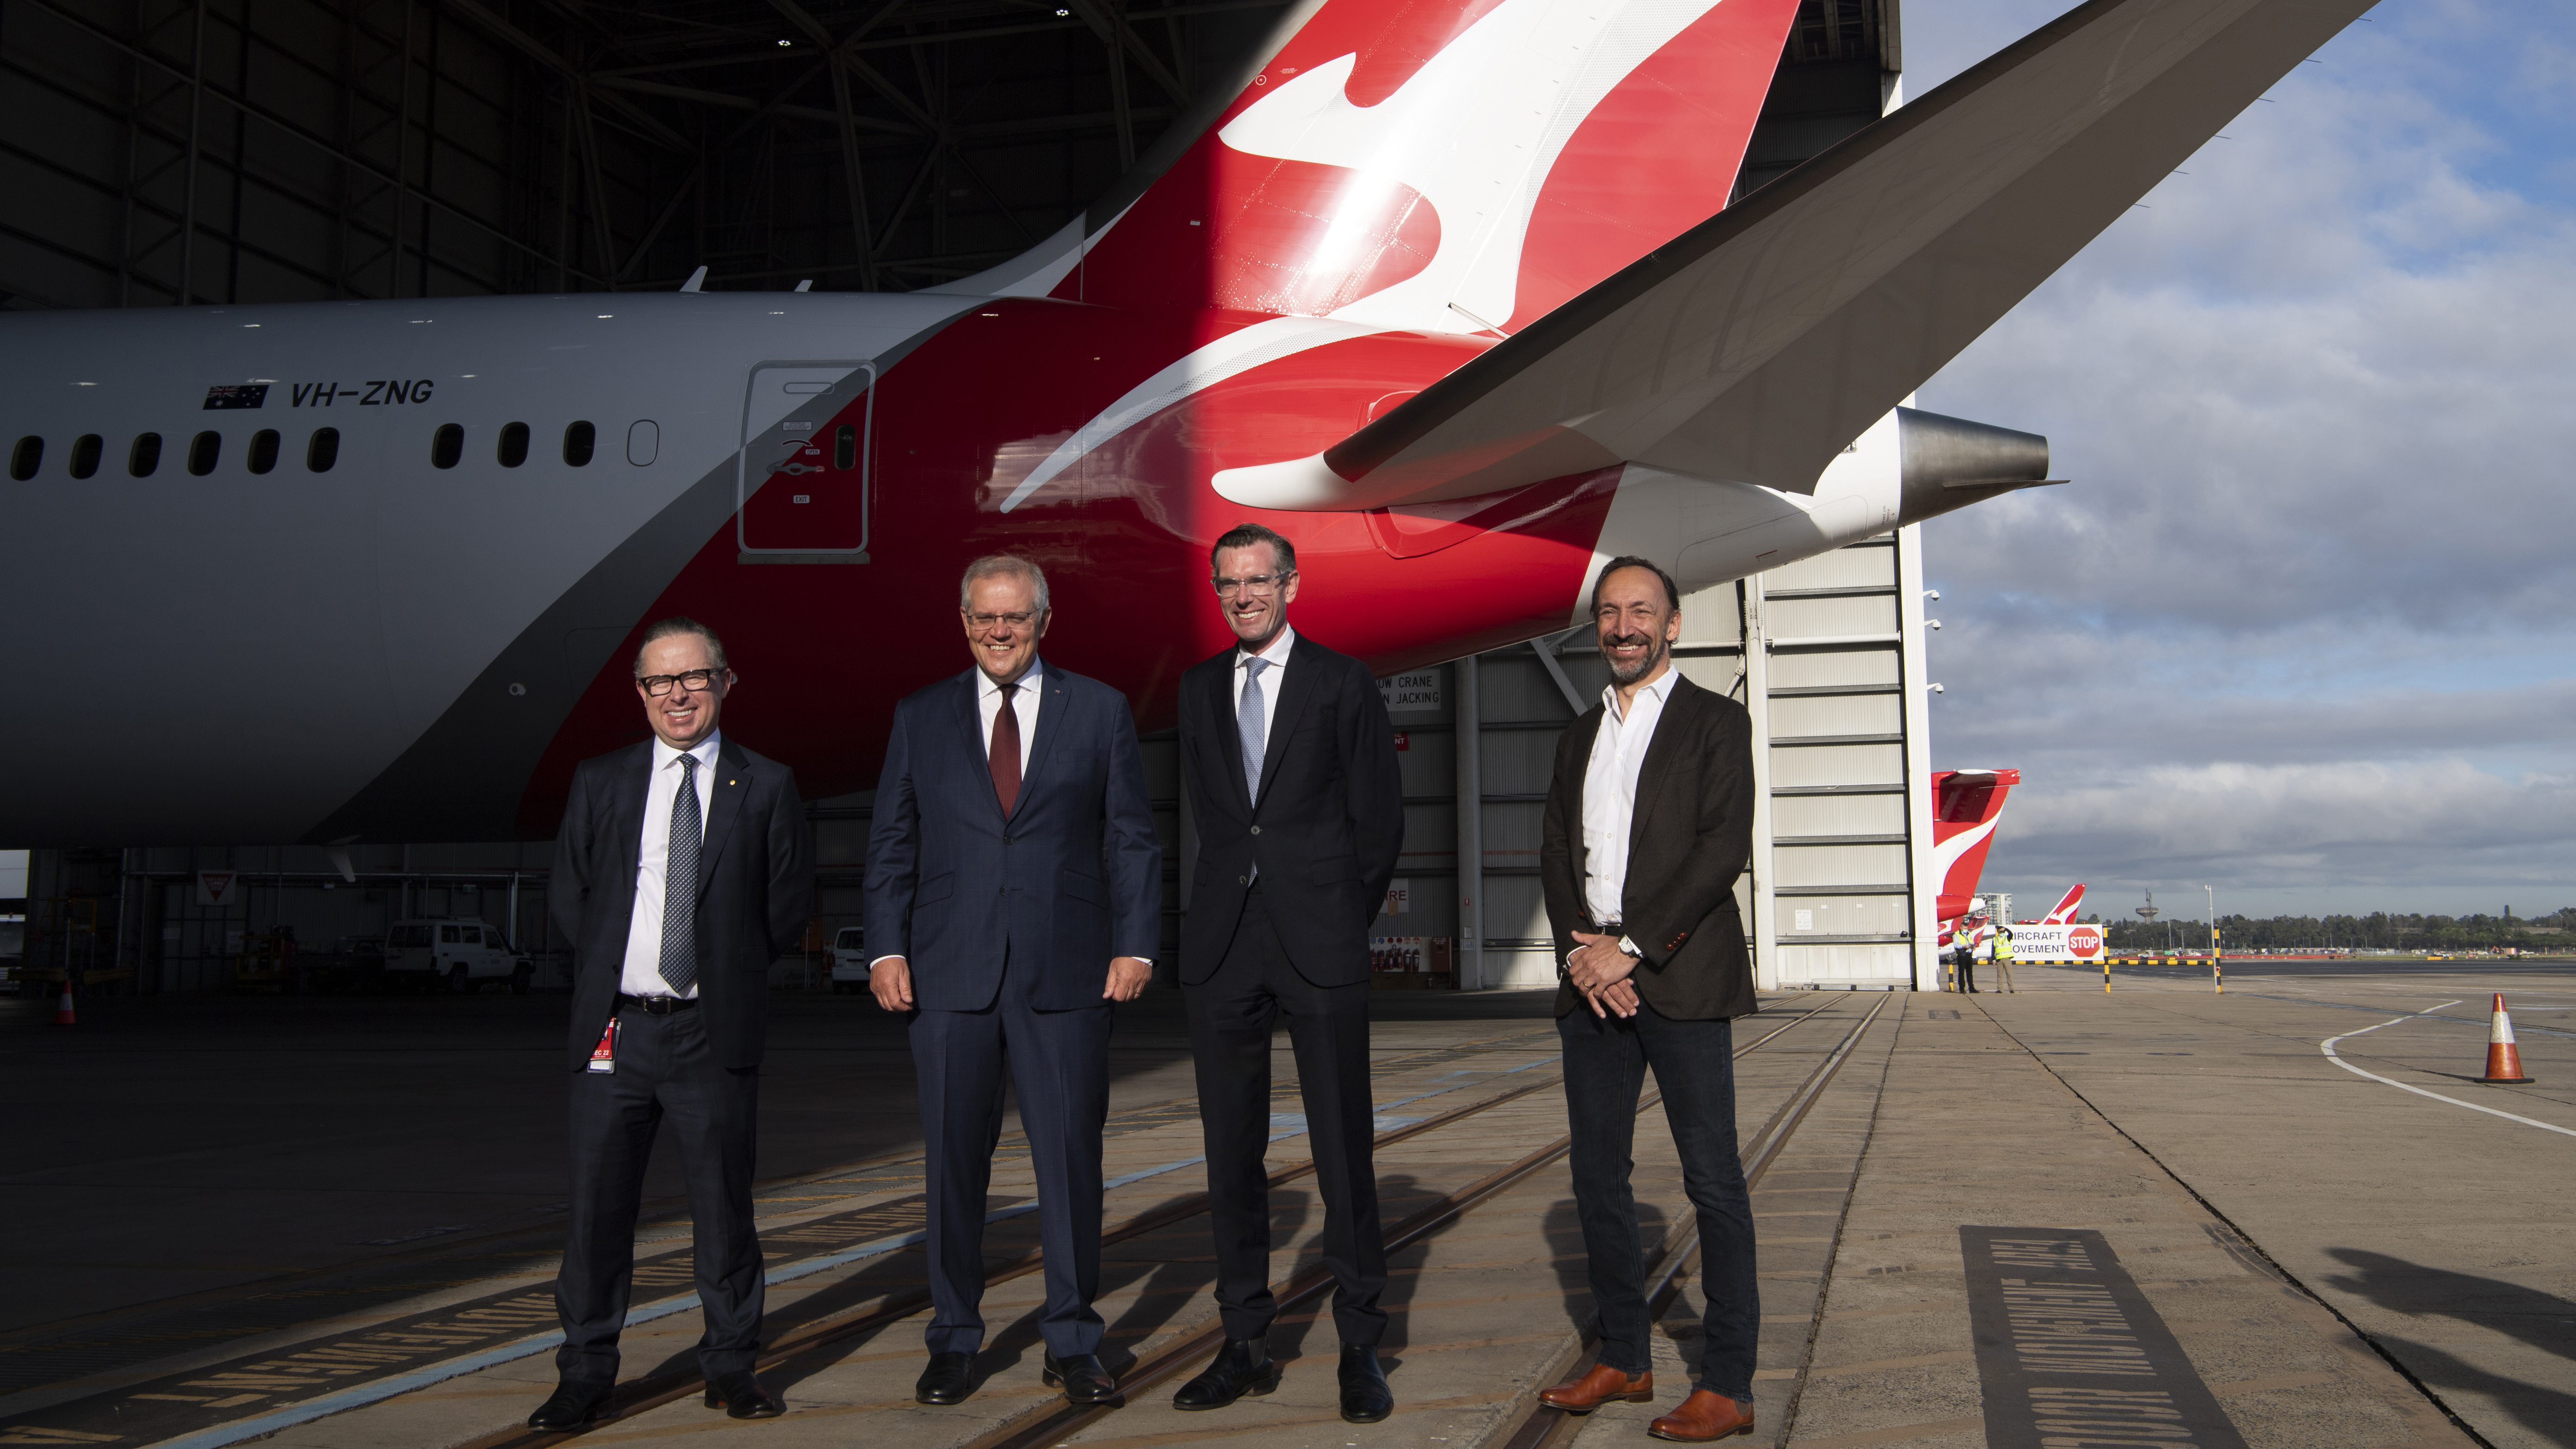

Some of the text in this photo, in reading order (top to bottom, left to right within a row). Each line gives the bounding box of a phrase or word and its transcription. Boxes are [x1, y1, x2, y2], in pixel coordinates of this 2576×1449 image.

[292, 379, 434, 407] VH-ZNG
[1378, 676, 1432, 688] OW CRANE
[1383, 692, 1439, 704] N JACKING
[1385, 890, 1406, 901] IRE
[2014, 932, 2062, 940] IRCRAFT
[2070, 936, 2099, 948] STOP
[2012, 945, 2066, 953] OVEMENT
[1989, 1238, 2097, 1271] AREA
[2001, 1278, 2158, 1376] MOVEMENT
